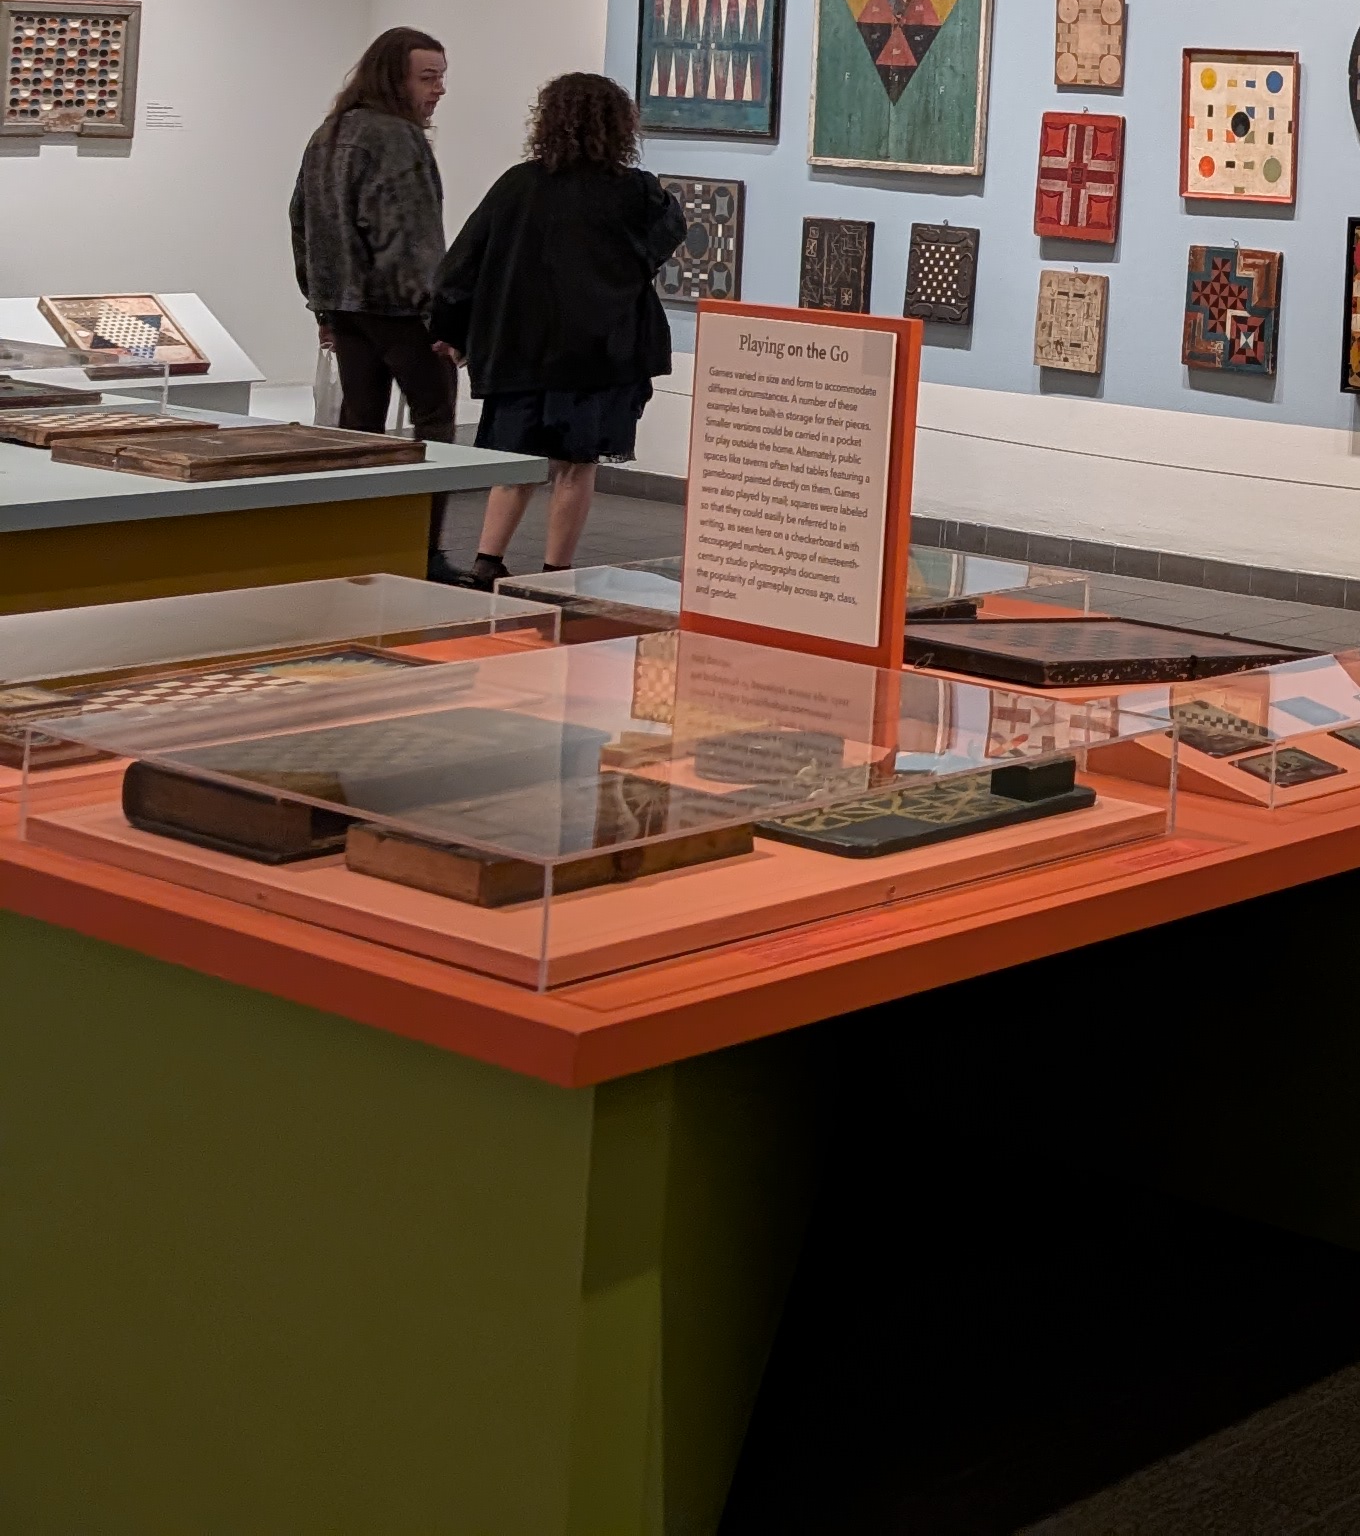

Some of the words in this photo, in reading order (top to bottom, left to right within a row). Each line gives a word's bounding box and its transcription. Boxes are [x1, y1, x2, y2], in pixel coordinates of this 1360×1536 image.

[738, 333, 785, 359] Playing
[787, 344, 803, 357] on
[806, 341, 827, 360] the
[829, 344, 849, 363] Go
[708, 366, 732, 378] Games
[734, 370, 756, 381] varied
[766, 373, 779, 384] size
[781, 376, 794, 386] and
[796, 376, 813, 388] form
[815, 380, 822, 390] to
[824, 382, 876, 396] accommodate
[741, 403, 757, 415] have
[785, 409, 813, 425] storage
[814, 413, 825, 424] for
[826, 414, 843, 427] their
[791, 393, 797, 403] A
[799, 395, 827, 407] number
[828, 398, 836, 408] of
[837, 399, 857, 411] these
[704, 432, 714, 443] for
[716, 434, 730, 448] play
[731, 438, 758, 449] outside
[759, 440, 771, 451] the
[838, 450, 861, 464] public
[732, 421, 760, 433] versions
[762, 425, 782, 436] could
[783, 426, 793, 437] be
[795, 429, 820, 441] carried
[836, 434, 861, 447] pocket
[703, 452, 727, 465] spaces
[729, 452, 740, 464] like
[770, 459, 788, 471] often
[790, 461, 804, 473] had
[806, 464, 828, 477] tables
[830, 466, 863, 484] featuring
[702, 468, 742, 481] gameboard
[772, 476, 798, 492] directly
[800, 483, 809, 491] on
[834, 485, 860, 499] Games
[700, 502, 708, 510] so
[710, 501, 724, 512] that
[725, 503, 740, 517] they
[743, 507, 762, 518] could
[786, 512, 796, 524] be
[798, 514, 827, 528] referred
[829, 518, 837, 530] to
[701, 485, 718, 494] were
[720, 485, 734, 497] also
[735, 488, 759, 503] played
[760, 491, 770, 505] by
[790, 499, 818, 512] squares
[820, 503, 838, 513] were
[840, 503, 868, 517] labeled
[727, 523, 735, 531] as
[737, 524, 753, 534] seen
[755, 524, 771, 537] here
[773, 530, 783, 539] on
[790, 530, 841, 548] checkerboard
[696, 551, 724, 566] century
[725, 555, 748, 567] studio
[749, 558, 796, 576] photographs
[798, 566, 840, 583] documents
[778, 545, 783, 556] A
[785, 549, 806, 562] group
[809, 551, 816, 561] of
[695, 584, 708, 594] and
[696, 566, 708, 577] the
[709, 571, 746, 586] popularity
[747, 575, 755, 585] of
[756, 578, 792, 595] gameplay
[794, 586, 817, 596] across
